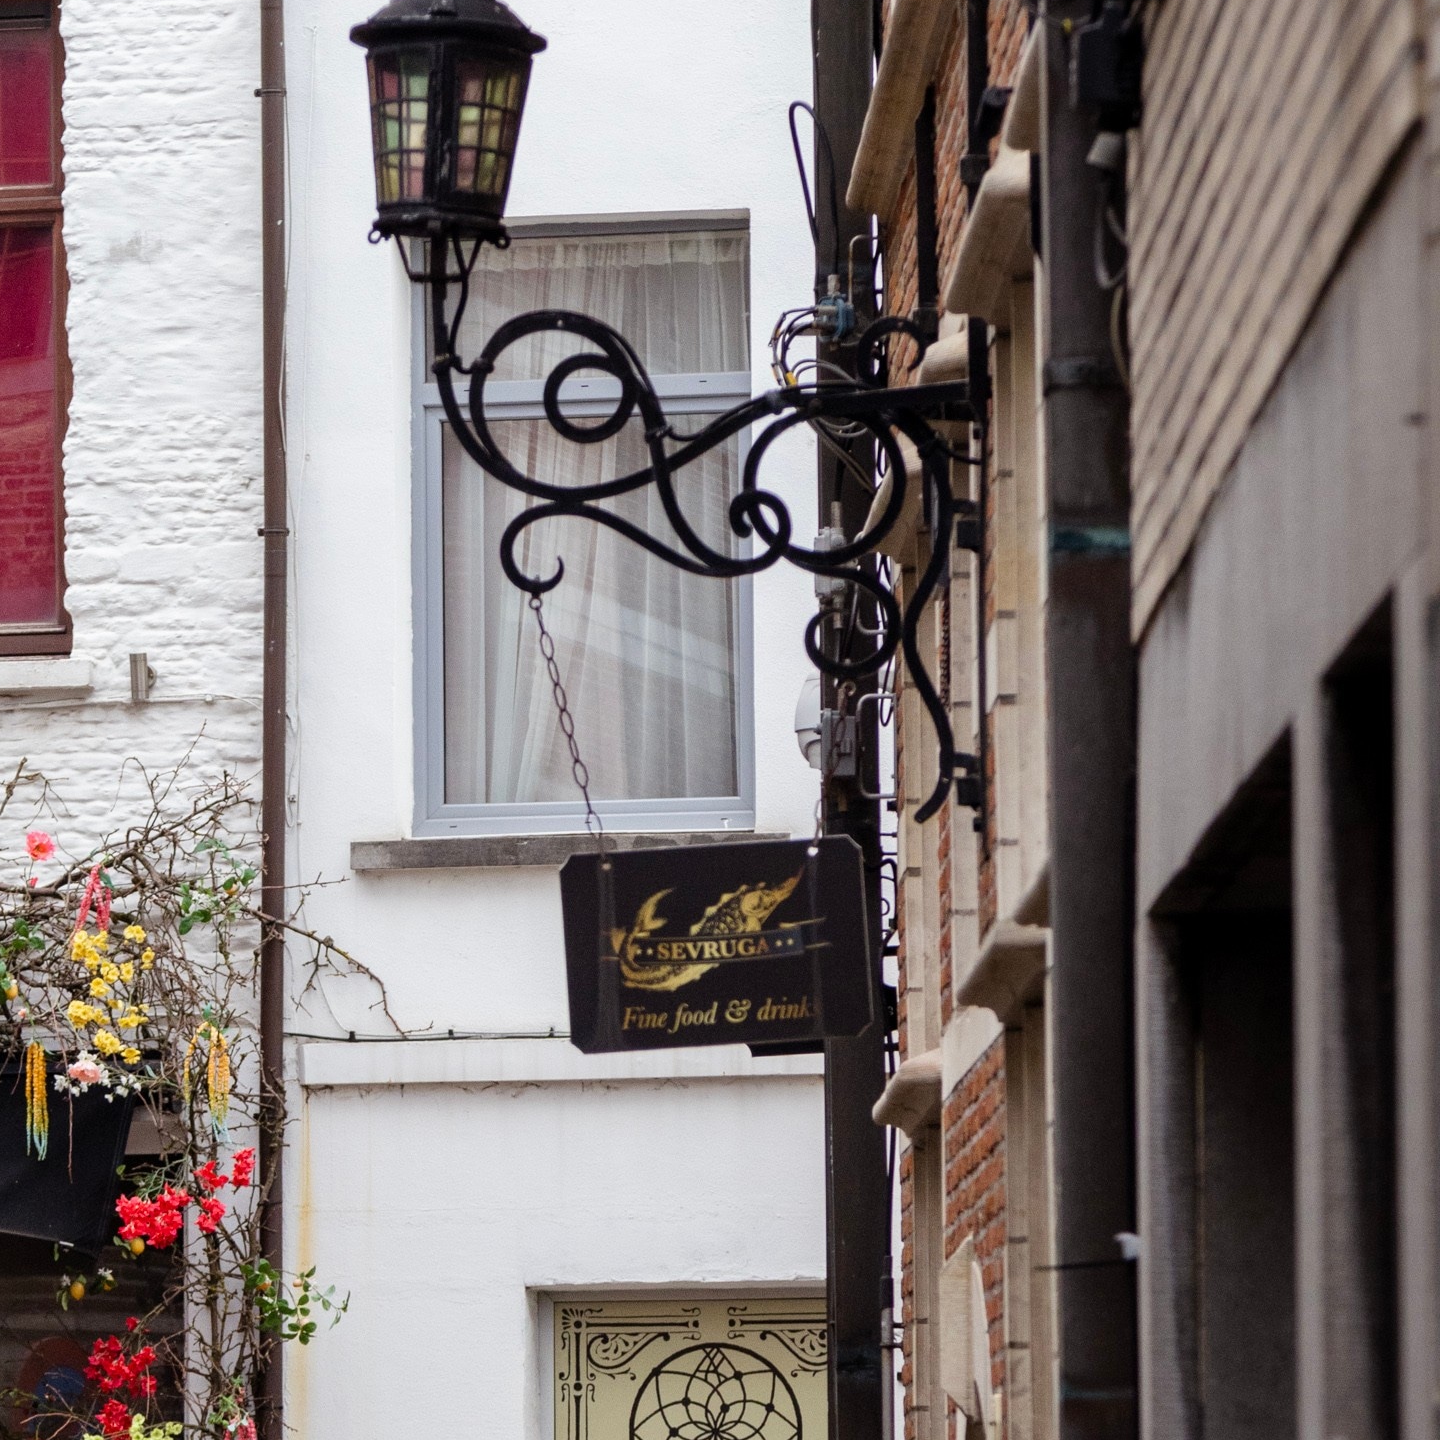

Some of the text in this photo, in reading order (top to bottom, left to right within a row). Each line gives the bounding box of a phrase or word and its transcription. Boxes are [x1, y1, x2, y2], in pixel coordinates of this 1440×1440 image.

[656, 937, 770, 961] SEVRUGA
[622, 1005, 667, 1031] Fine
[668, 1001, 718, 1034] food
[724, 998, 752, 1024] &
